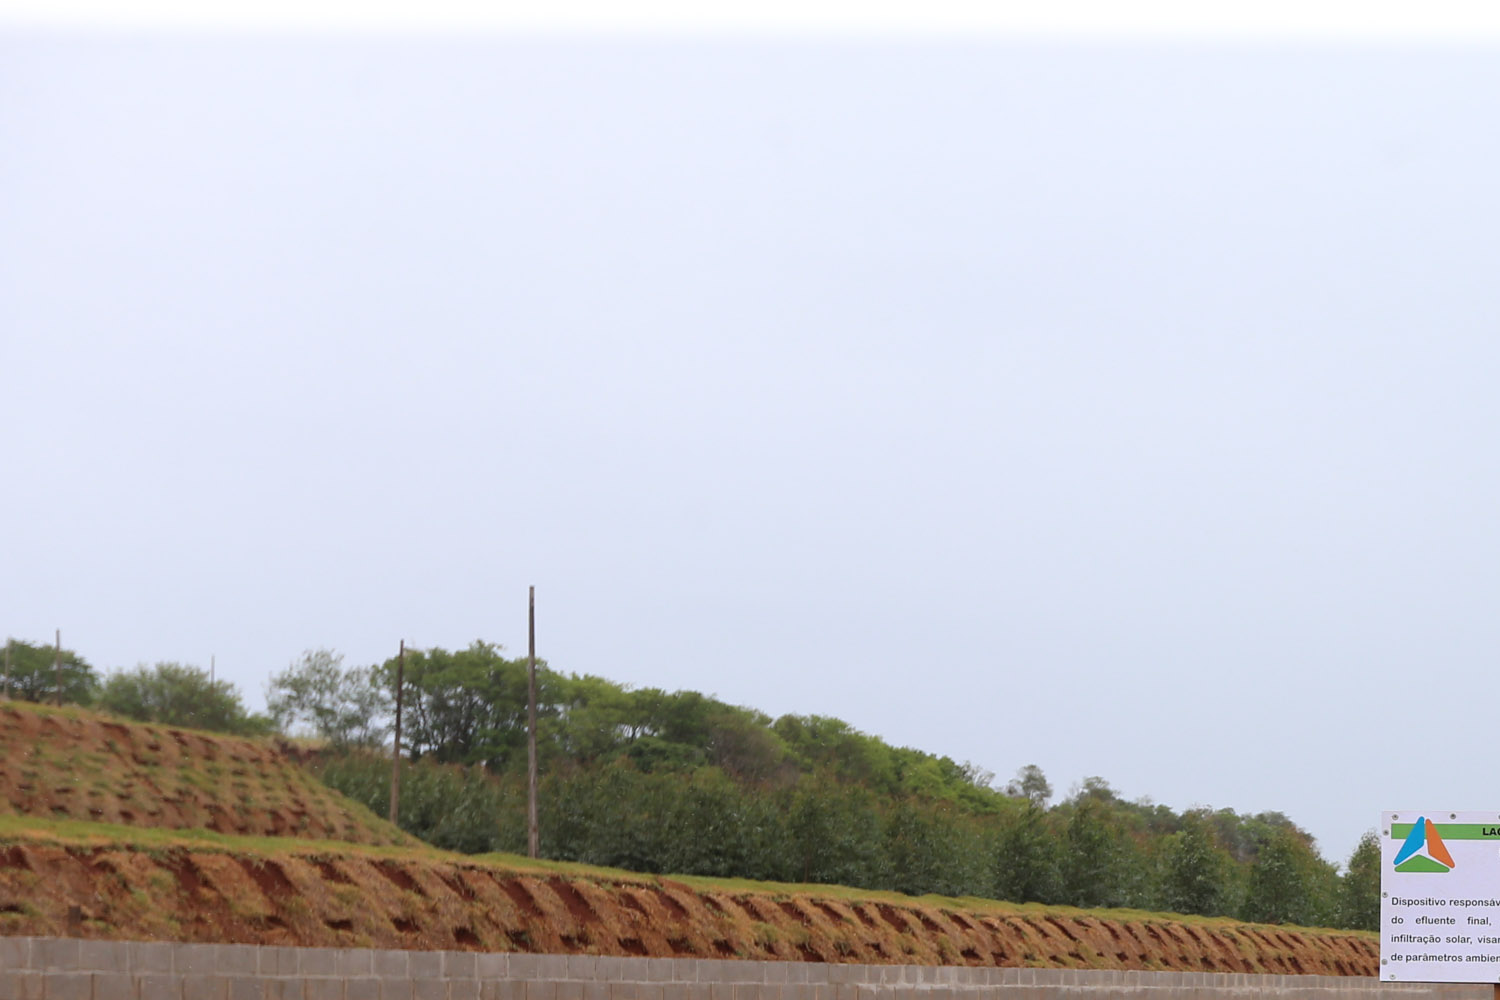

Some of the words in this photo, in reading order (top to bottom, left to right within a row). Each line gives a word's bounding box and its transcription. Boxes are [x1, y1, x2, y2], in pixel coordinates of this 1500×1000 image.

[1392, 898, 1446, 908] Dispositivo
[1390, 916, 1404, 924] do
[1416, 916, 1456, 924] efluente
[1468, 916, 1492, 926] final,
[1392, 934, 1440, 944] infiltração
[1446, 936, 1472, 944] solar,
[1390, 952, 1402, 962] de
[1406, 954, 1462, 962] parâmetros
